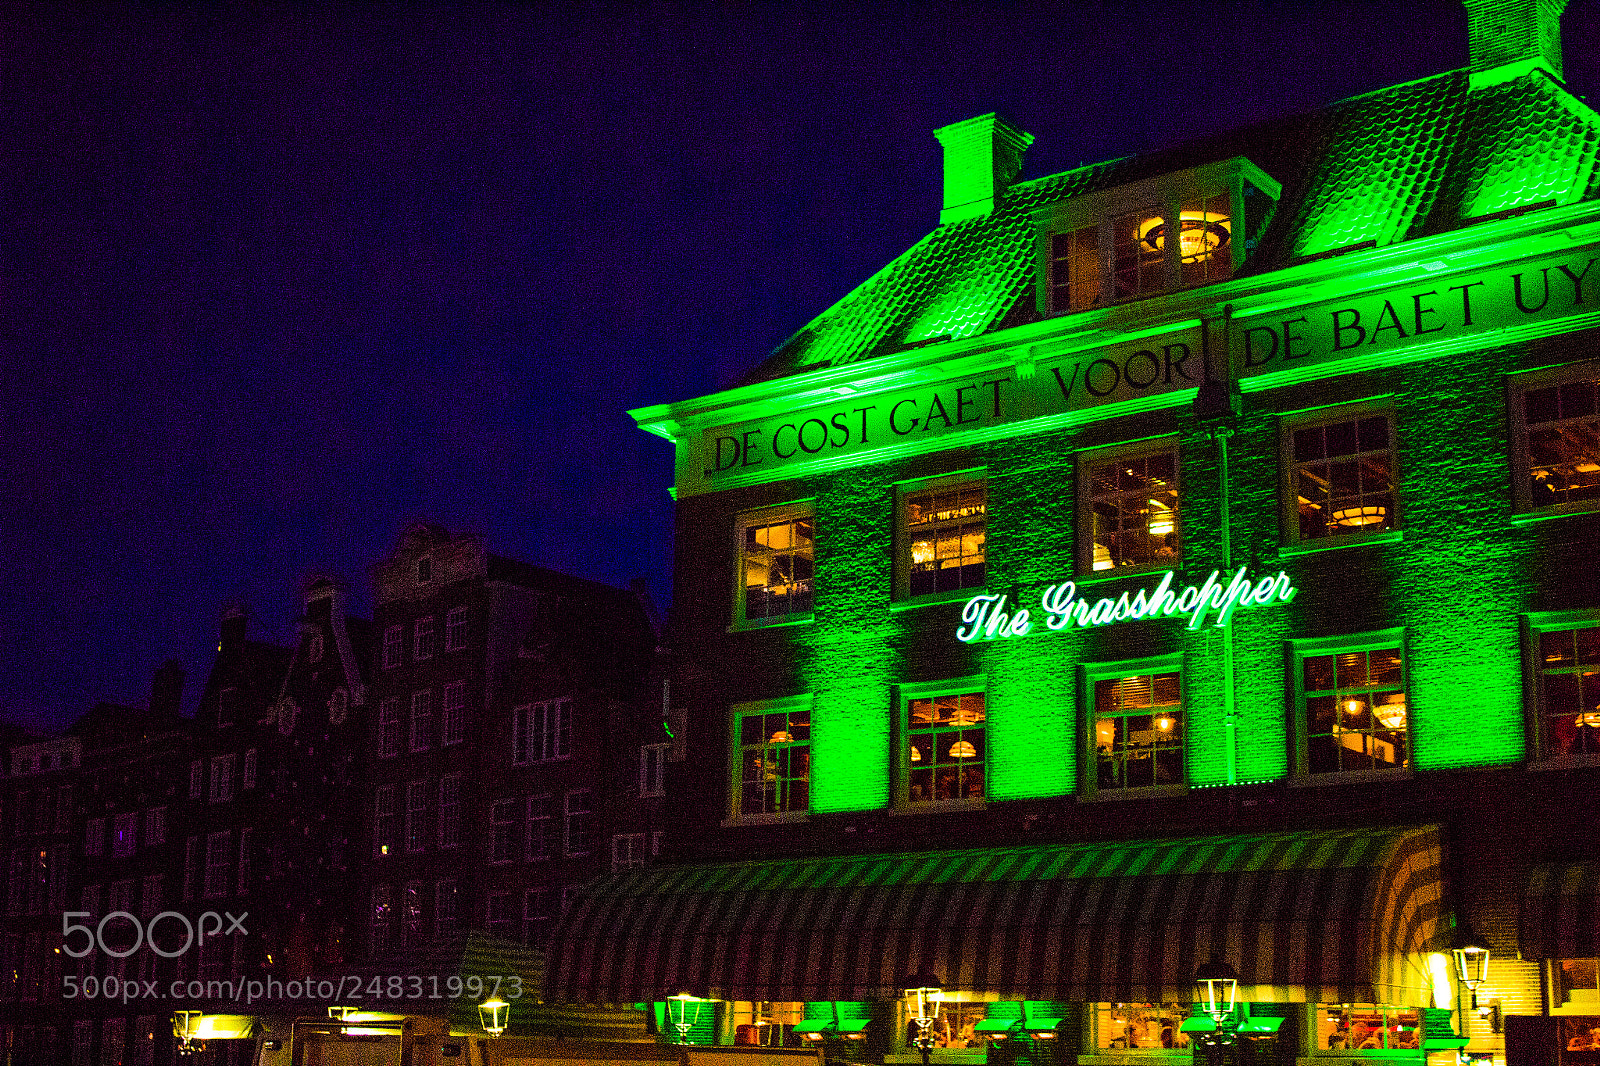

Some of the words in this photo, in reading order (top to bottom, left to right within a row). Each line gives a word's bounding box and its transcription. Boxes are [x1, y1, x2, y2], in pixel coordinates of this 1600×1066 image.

[772, 406, 877, 459] COST
[889, 377, 1013, 436] GAET
[1051, 342, 1192, 400] VOOR
[1244, 316, 1312, 368] DE
[1331, 281, 1485, 351] BAET
[956, 594, 1031, 643] The
[1042, 566, 1296, 631] Grasshopper
